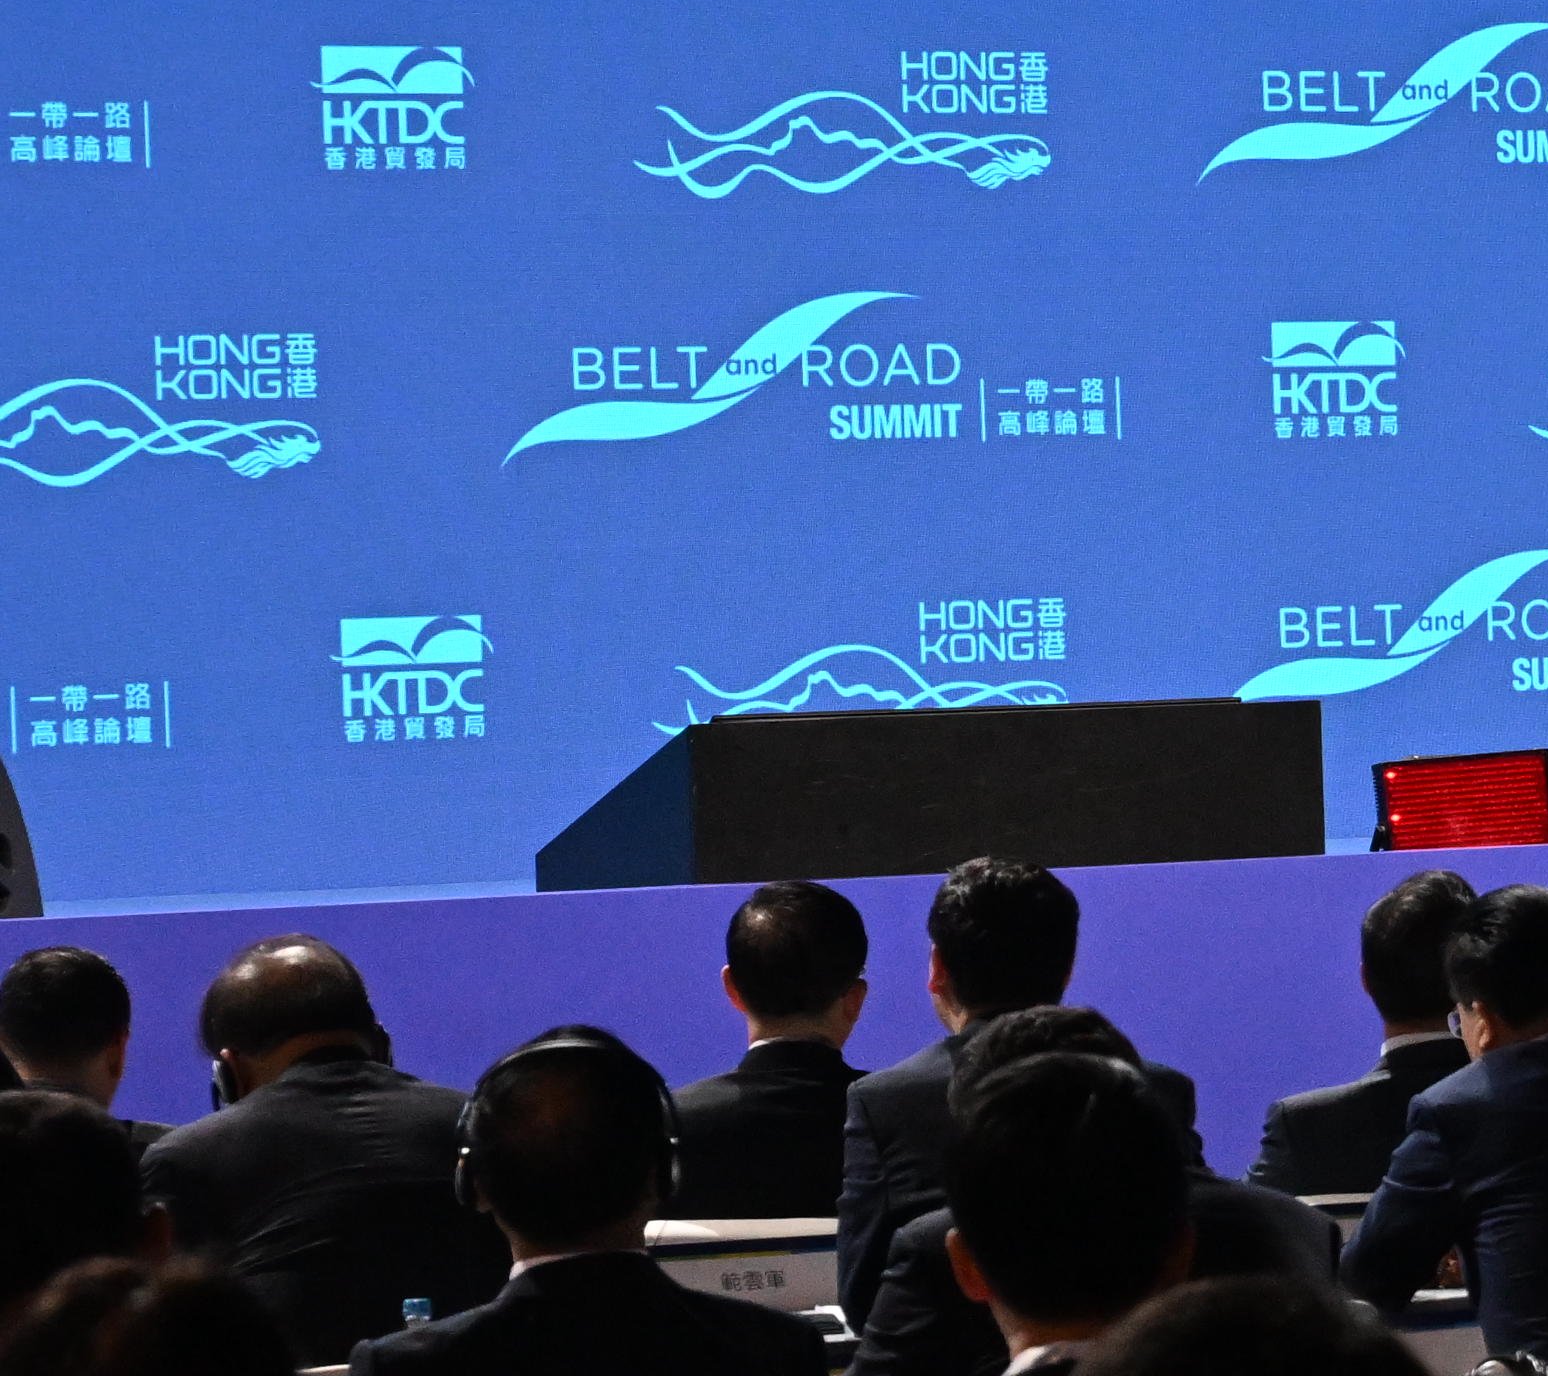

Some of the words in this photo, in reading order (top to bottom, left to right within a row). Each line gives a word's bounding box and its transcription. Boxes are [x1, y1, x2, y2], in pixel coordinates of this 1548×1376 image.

[343, 670, 484, 716] HKTDC
[345, 716, 484, 741] 香港貿發局
